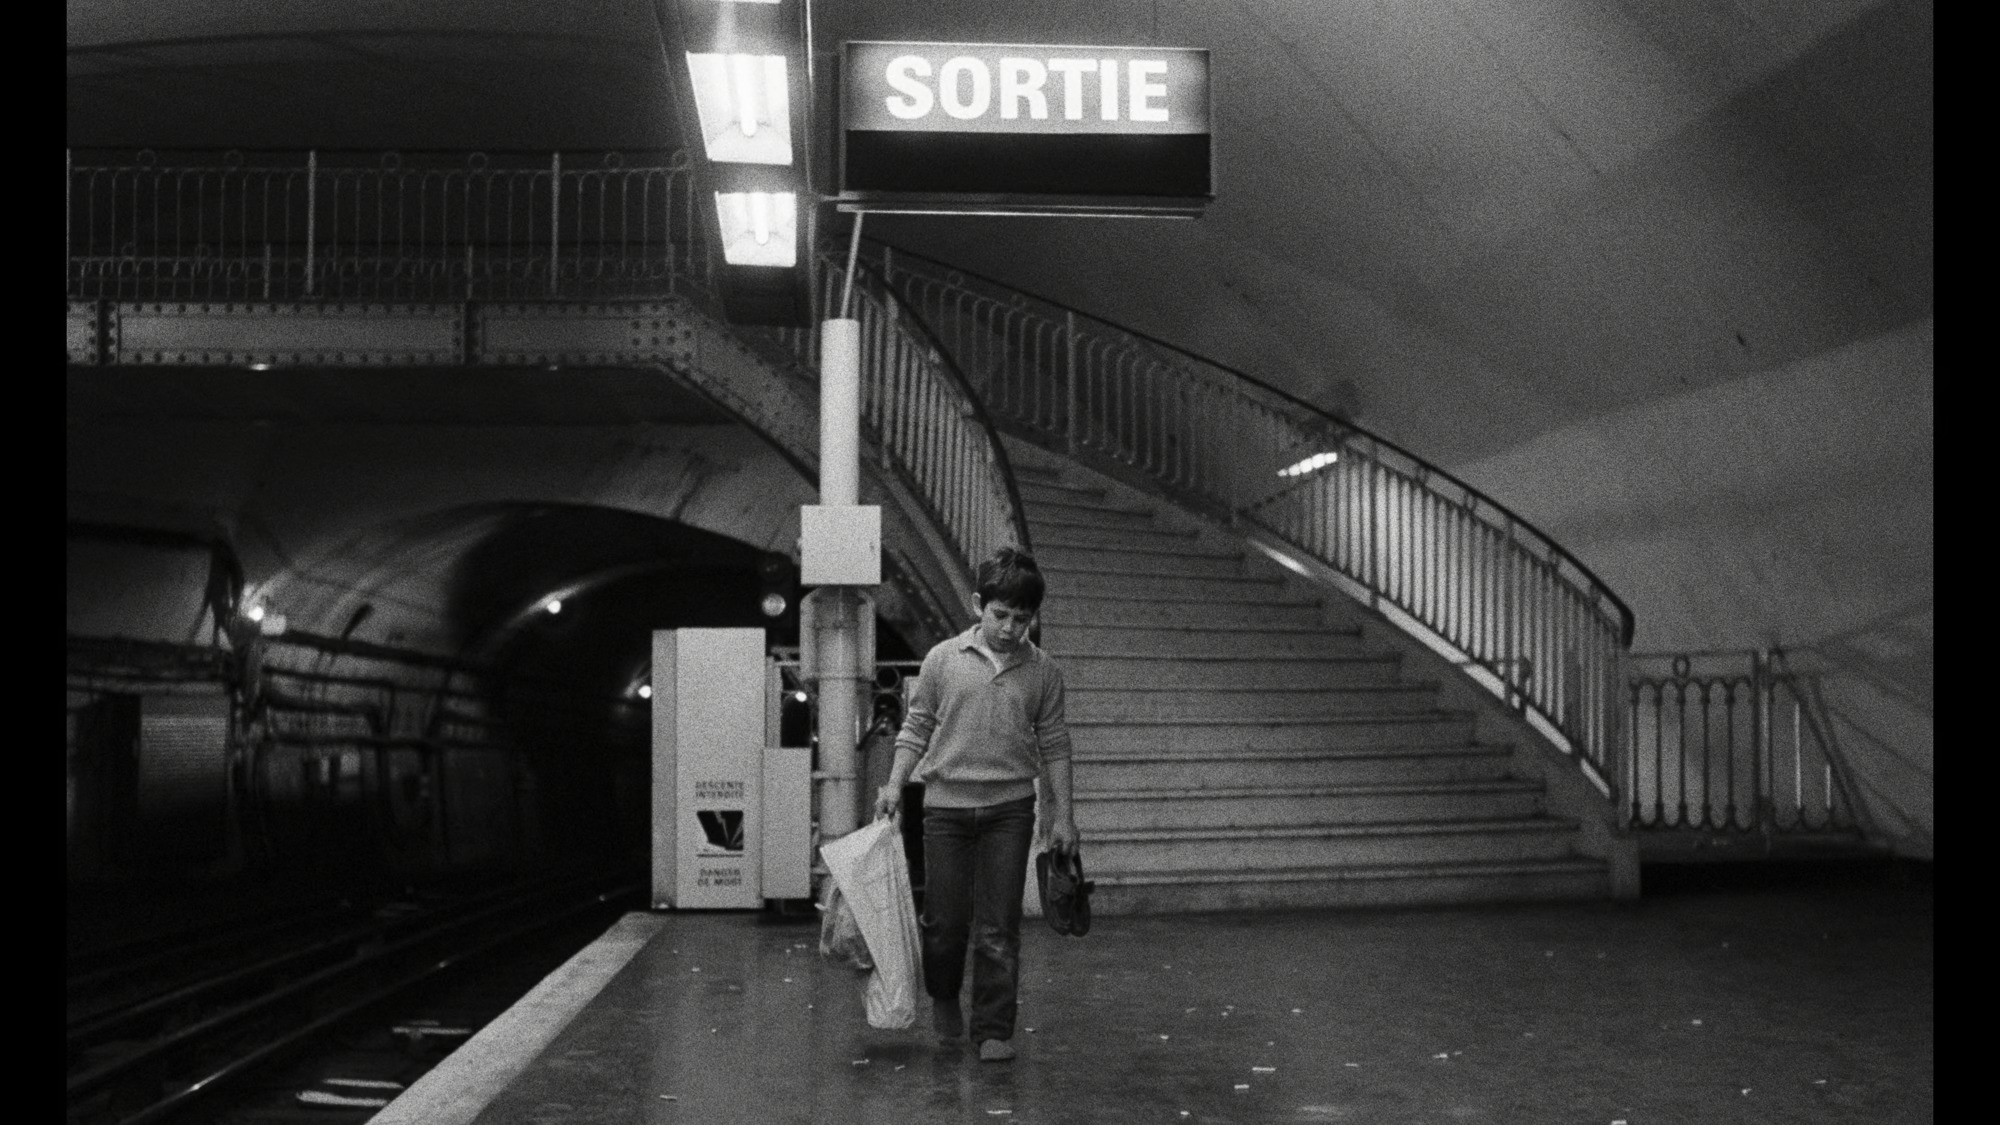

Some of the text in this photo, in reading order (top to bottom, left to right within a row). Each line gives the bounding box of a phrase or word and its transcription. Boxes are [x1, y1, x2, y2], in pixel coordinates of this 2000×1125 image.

[885, 55, 1169, 122] SORTIE
[695, 781, 744, 790] DESCENTE
[695, 791, 744, 799] INTERDITE
[700, 868, 740, 876] DANGER
[697, 878, 742, 887] DE MORT
